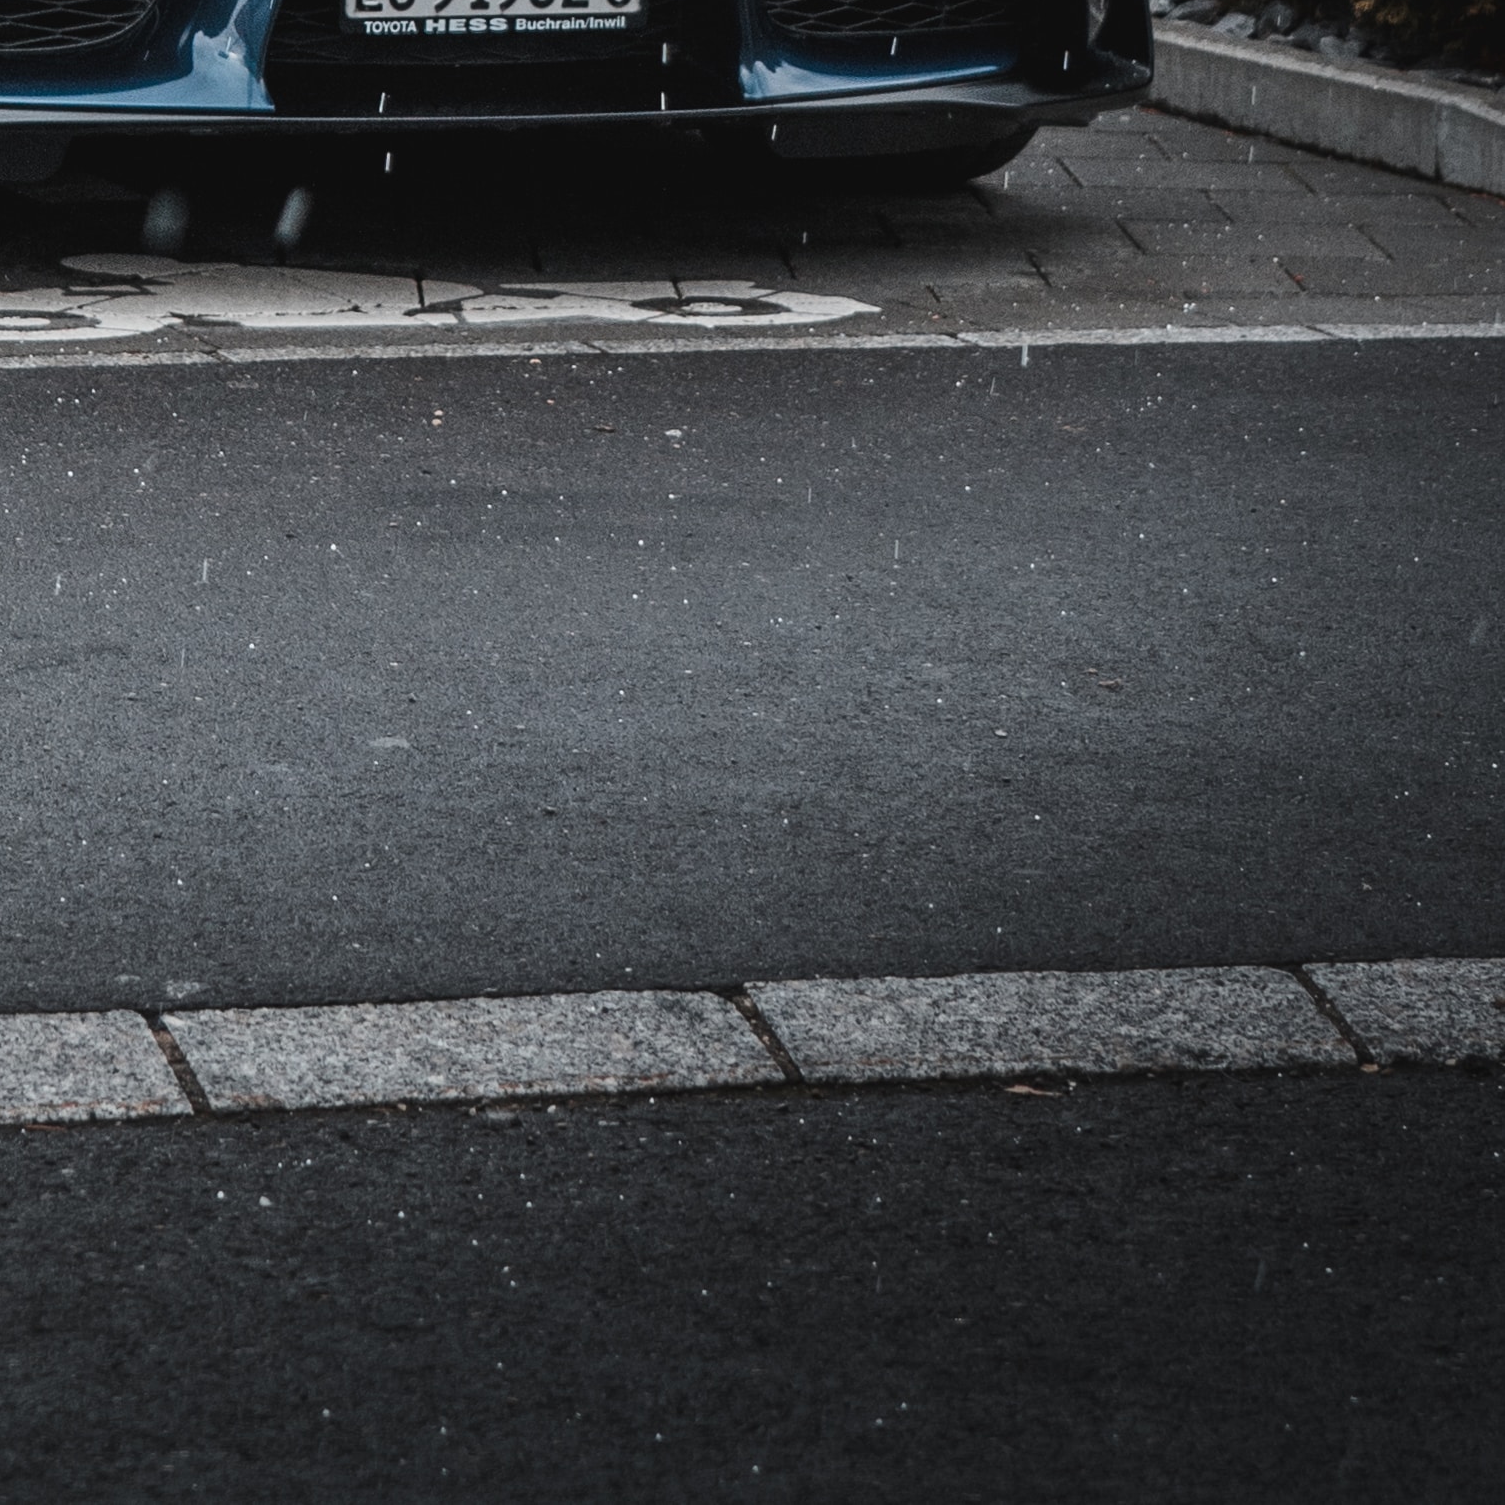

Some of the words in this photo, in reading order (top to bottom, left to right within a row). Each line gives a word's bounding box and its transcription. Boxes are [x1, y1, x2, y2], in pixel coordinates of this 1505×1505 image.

[364, 20, 417, 34] TOYOTA
[425, 17, 509, 33] HESS
[515, 15, 627, 31] Buchrain/Inwil
